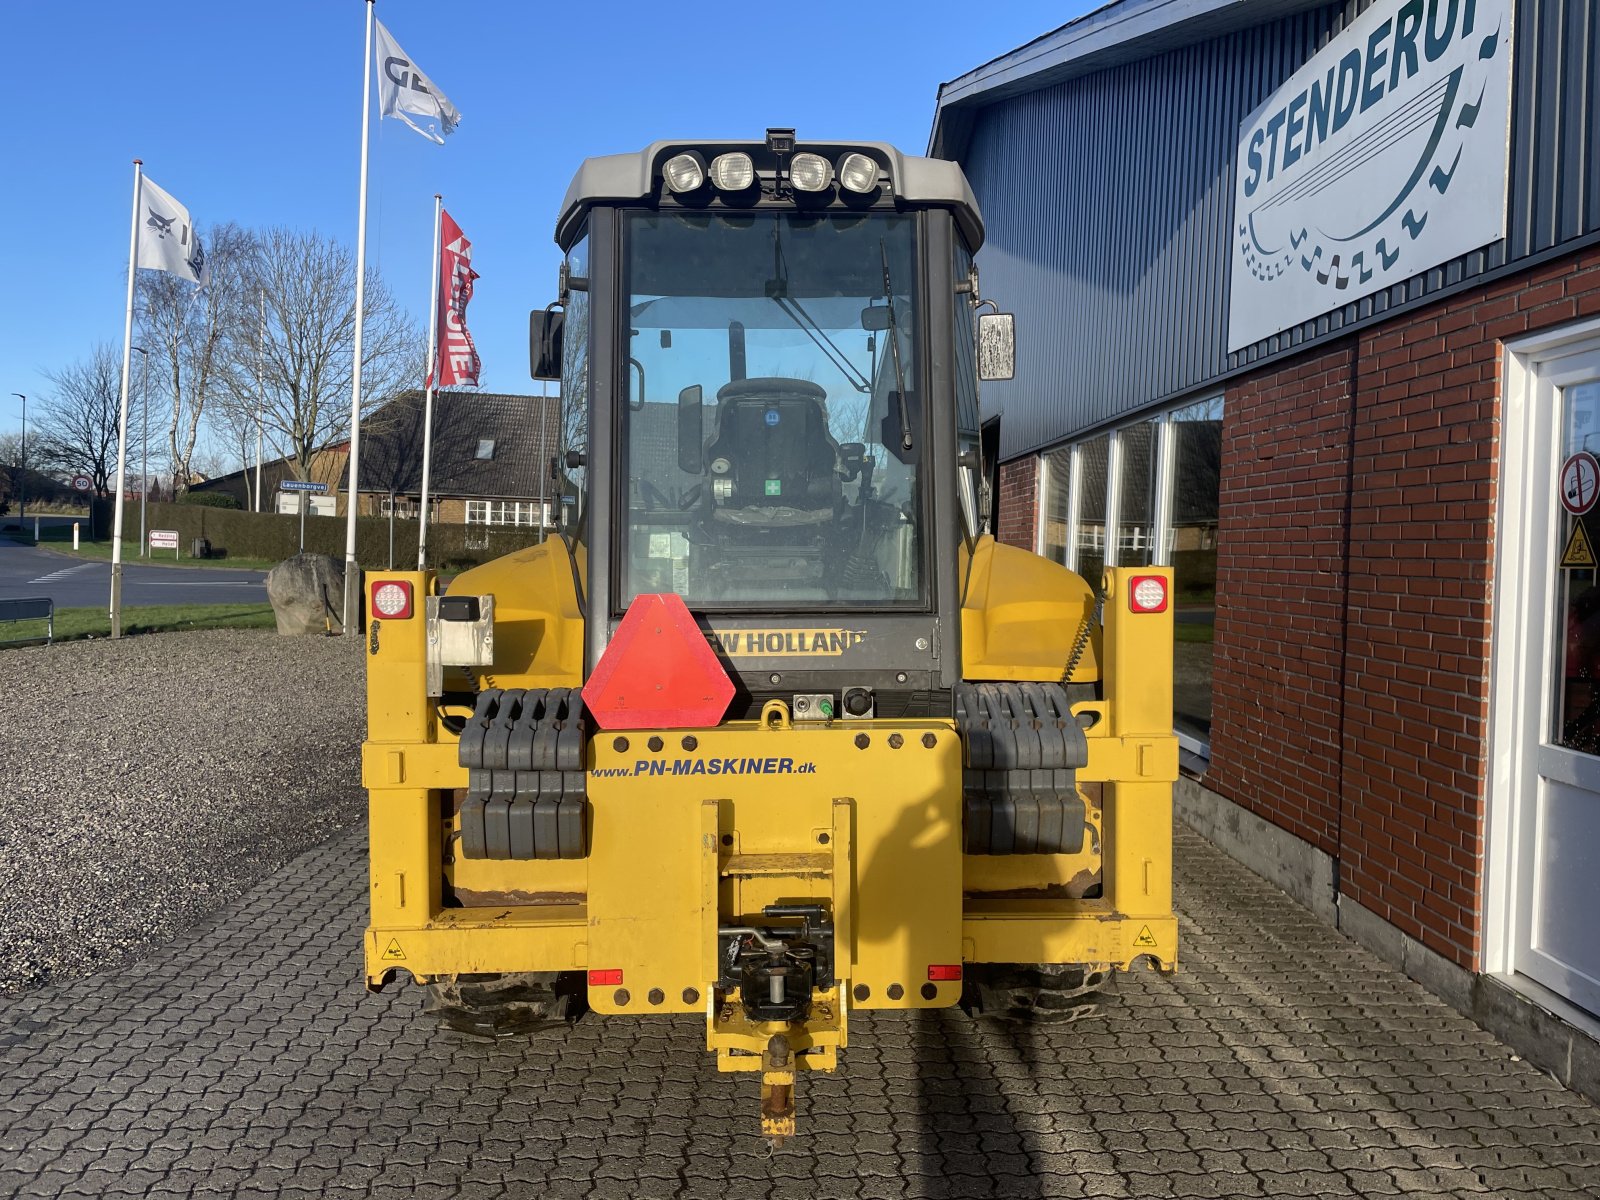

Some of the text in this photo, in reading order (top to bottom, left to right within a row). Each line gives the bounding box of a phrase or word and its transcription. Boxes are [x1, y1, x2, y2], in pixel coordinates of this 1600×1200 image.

[282, 481, 327, 491] Lauenborgvej
[703, 632, 739, 653] EW
[590, 757, 817, 778] www.PN-MASKINER.dk
